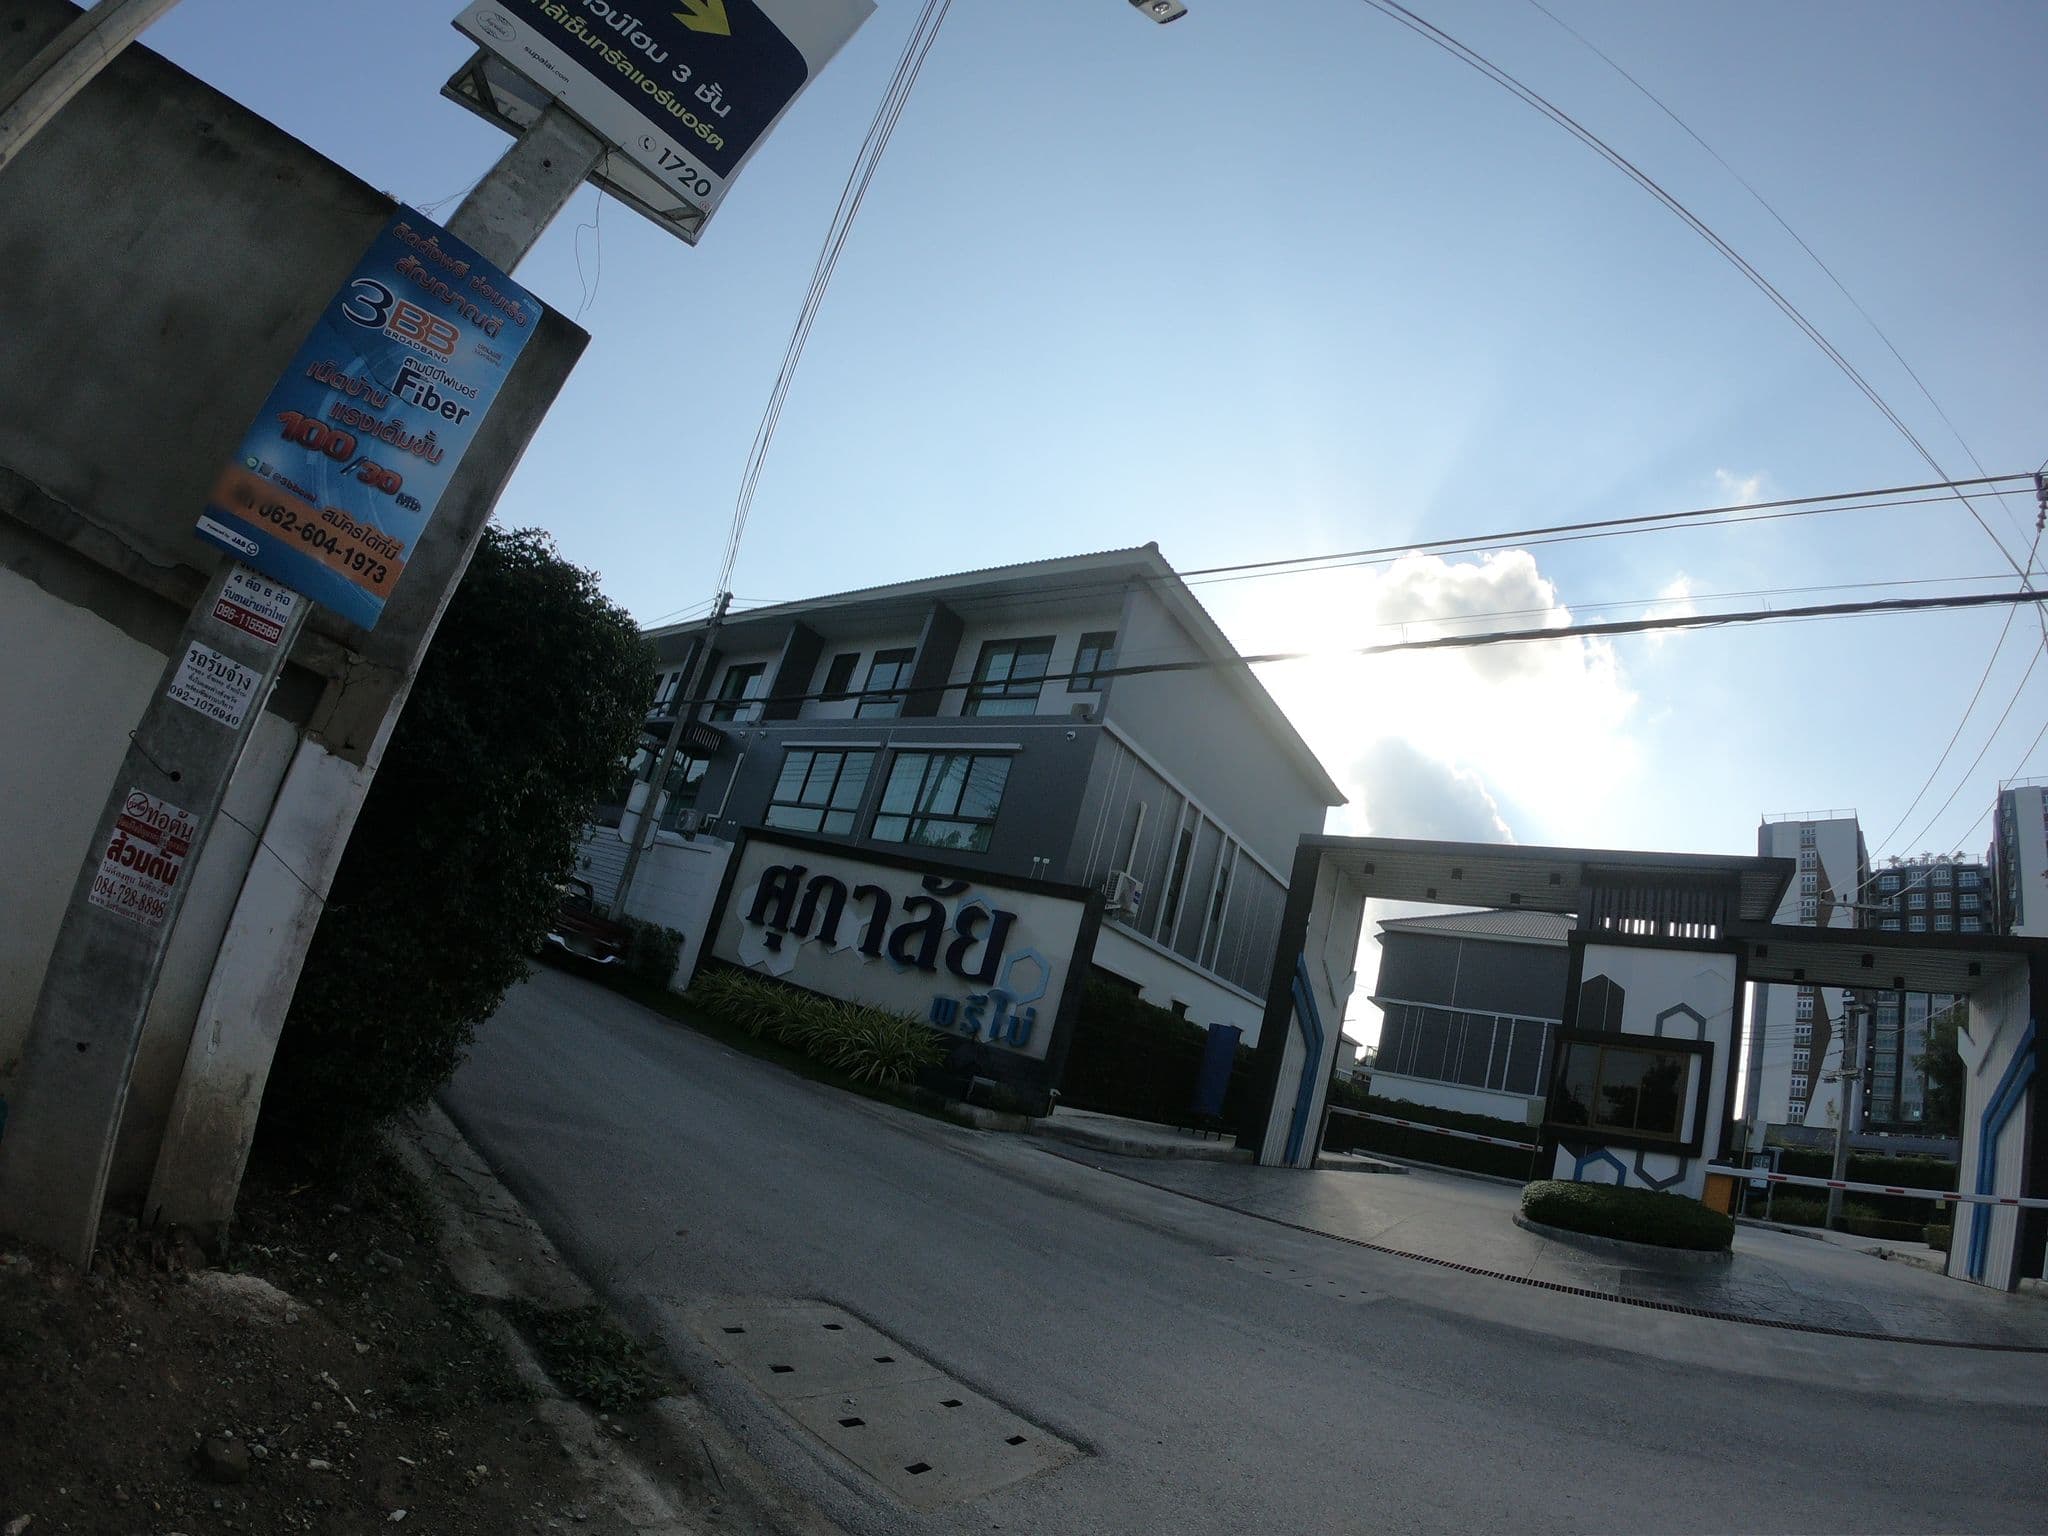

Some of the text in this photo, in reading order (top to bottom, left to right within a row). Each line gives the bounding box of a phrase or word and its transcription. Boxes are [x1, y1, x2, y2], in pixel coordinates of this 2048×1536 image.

[523, 46, 570, 84] supalai.com
[671, 64, 692, 83] 3
[694, 82, 732, 118] ชั้น
[656, 147, 712, 198] 1720
[342, 278, 460, 356] 3BB
[384, 329, 449, 365] BROADBAND
[391, 367, 470, 425] Fiber
[234, 574, 243, 585] 4
[264, 587, 273, 598] 6
[188, 649, 251, 690] รถรับจ้าง
[147, 802, 194, 841] ท่อตัน
[106, 831, 180, 887] ส้วมตัน
